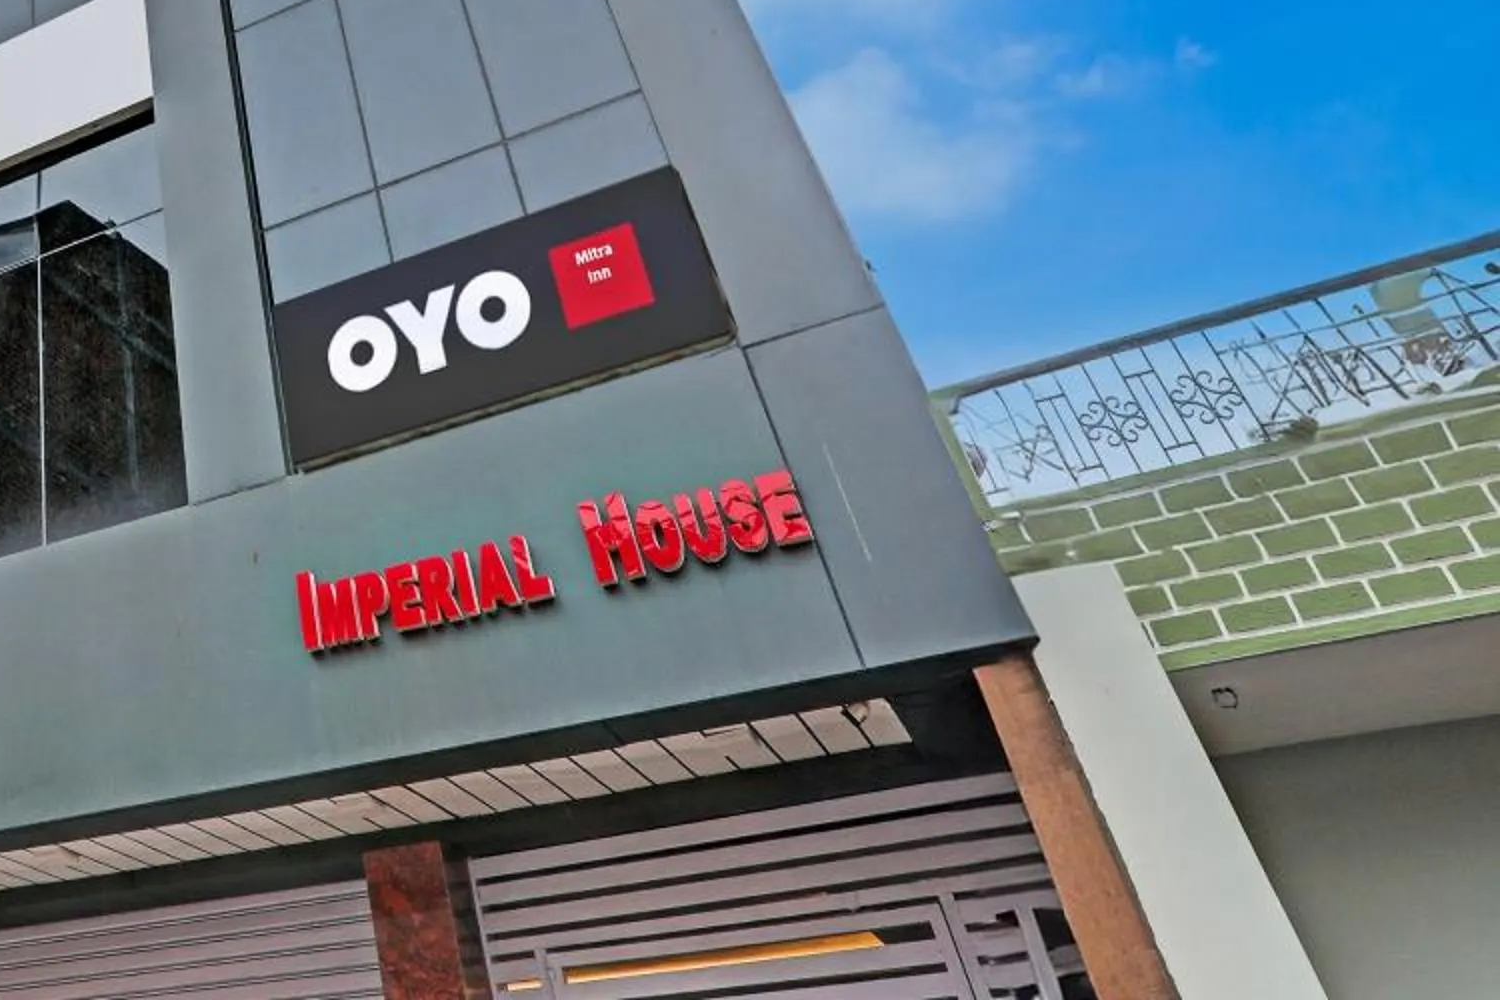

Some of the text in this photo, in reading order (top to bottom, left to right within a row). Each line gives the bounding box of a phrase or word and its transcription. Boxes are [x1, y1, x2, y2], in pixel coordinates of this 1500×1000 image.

[575, 244, 613, 266] Mitra
[587, 267, 612, 284] Inn
[327, 270, 531, 392] OYO
[296, 470, 813, 653] IMPERIAL HOUSE
